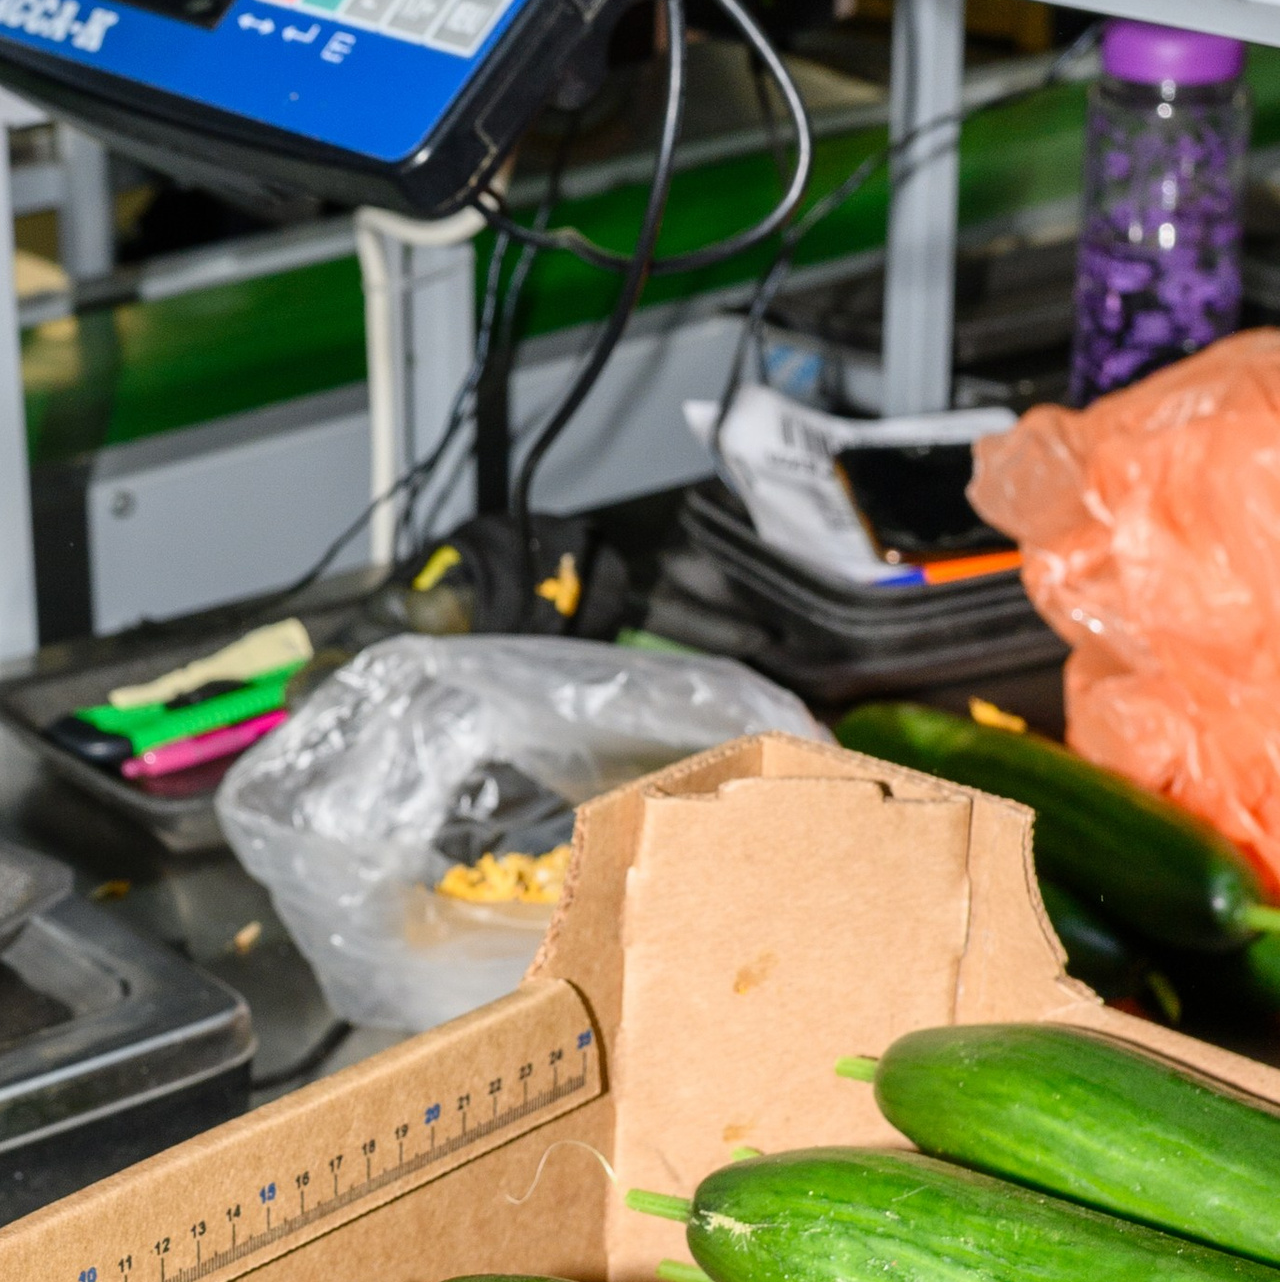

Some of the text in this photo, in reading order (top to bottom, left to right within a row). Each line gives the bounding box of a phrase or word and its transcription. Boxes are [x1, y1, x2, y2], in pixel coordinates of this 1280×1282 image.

[118, 1255, 134, 1273] 11
[154, 1237, 172, 1256] 12
[190, 1221, 207, 1239] 13
[226, 1203, 242, 1222] 14
[258, 1182, 277, 1204] 15
[295, 1171, 310, 1190] 16
[328, 1154, 344, 1173] 17
[361, 1138, 377, 1157] 18
[394, 1123, 410, 1141] 19
